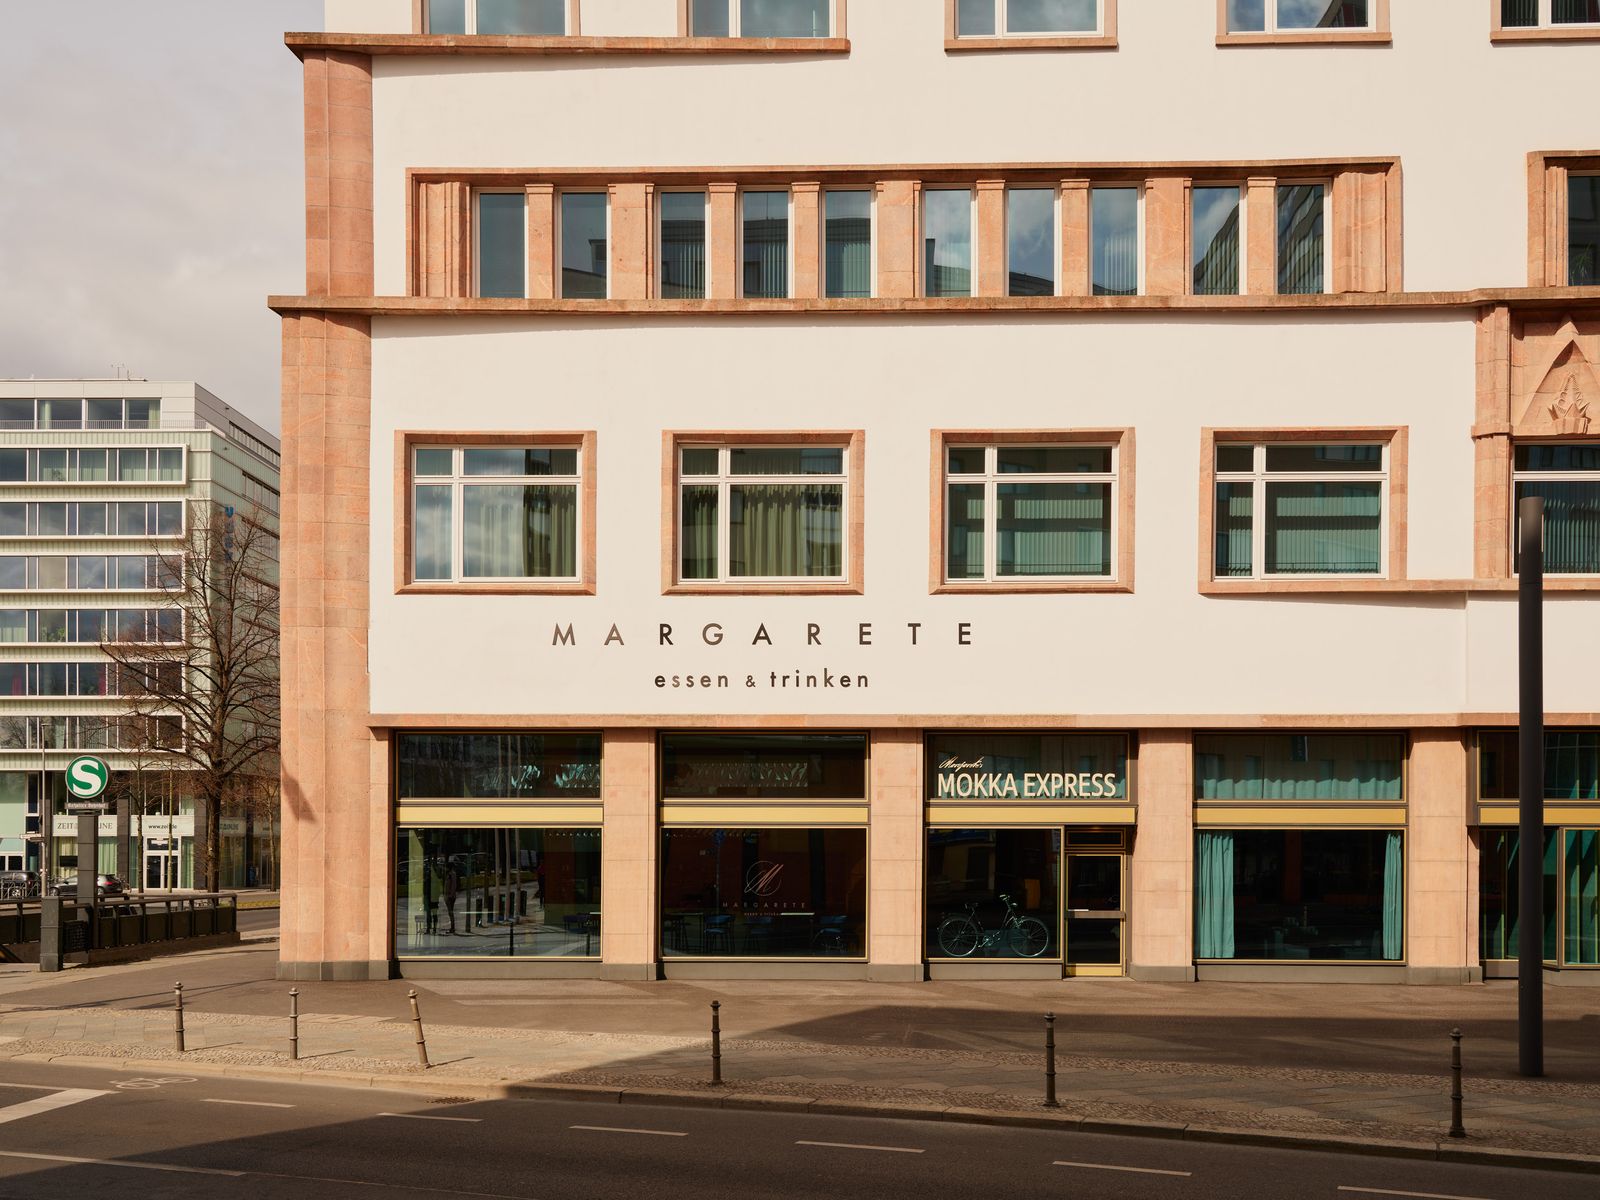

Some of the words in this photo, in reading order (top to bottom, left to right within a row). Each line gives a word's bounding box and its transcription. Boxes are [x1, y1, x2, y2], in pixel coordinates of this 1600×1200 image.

[552, 623, 972, 646] MARGARETE
[655, 674, 729, 688] essen
[745, 675, 757, 688] &
[770, 668, 868, 688] trinken
[71, 759, 102, 796] S
[937, 772, 1019, 797] MOKKA
[1023, 772, 1117, 797] EXPRESS
[57, 822, 74, 830] ZEIT
